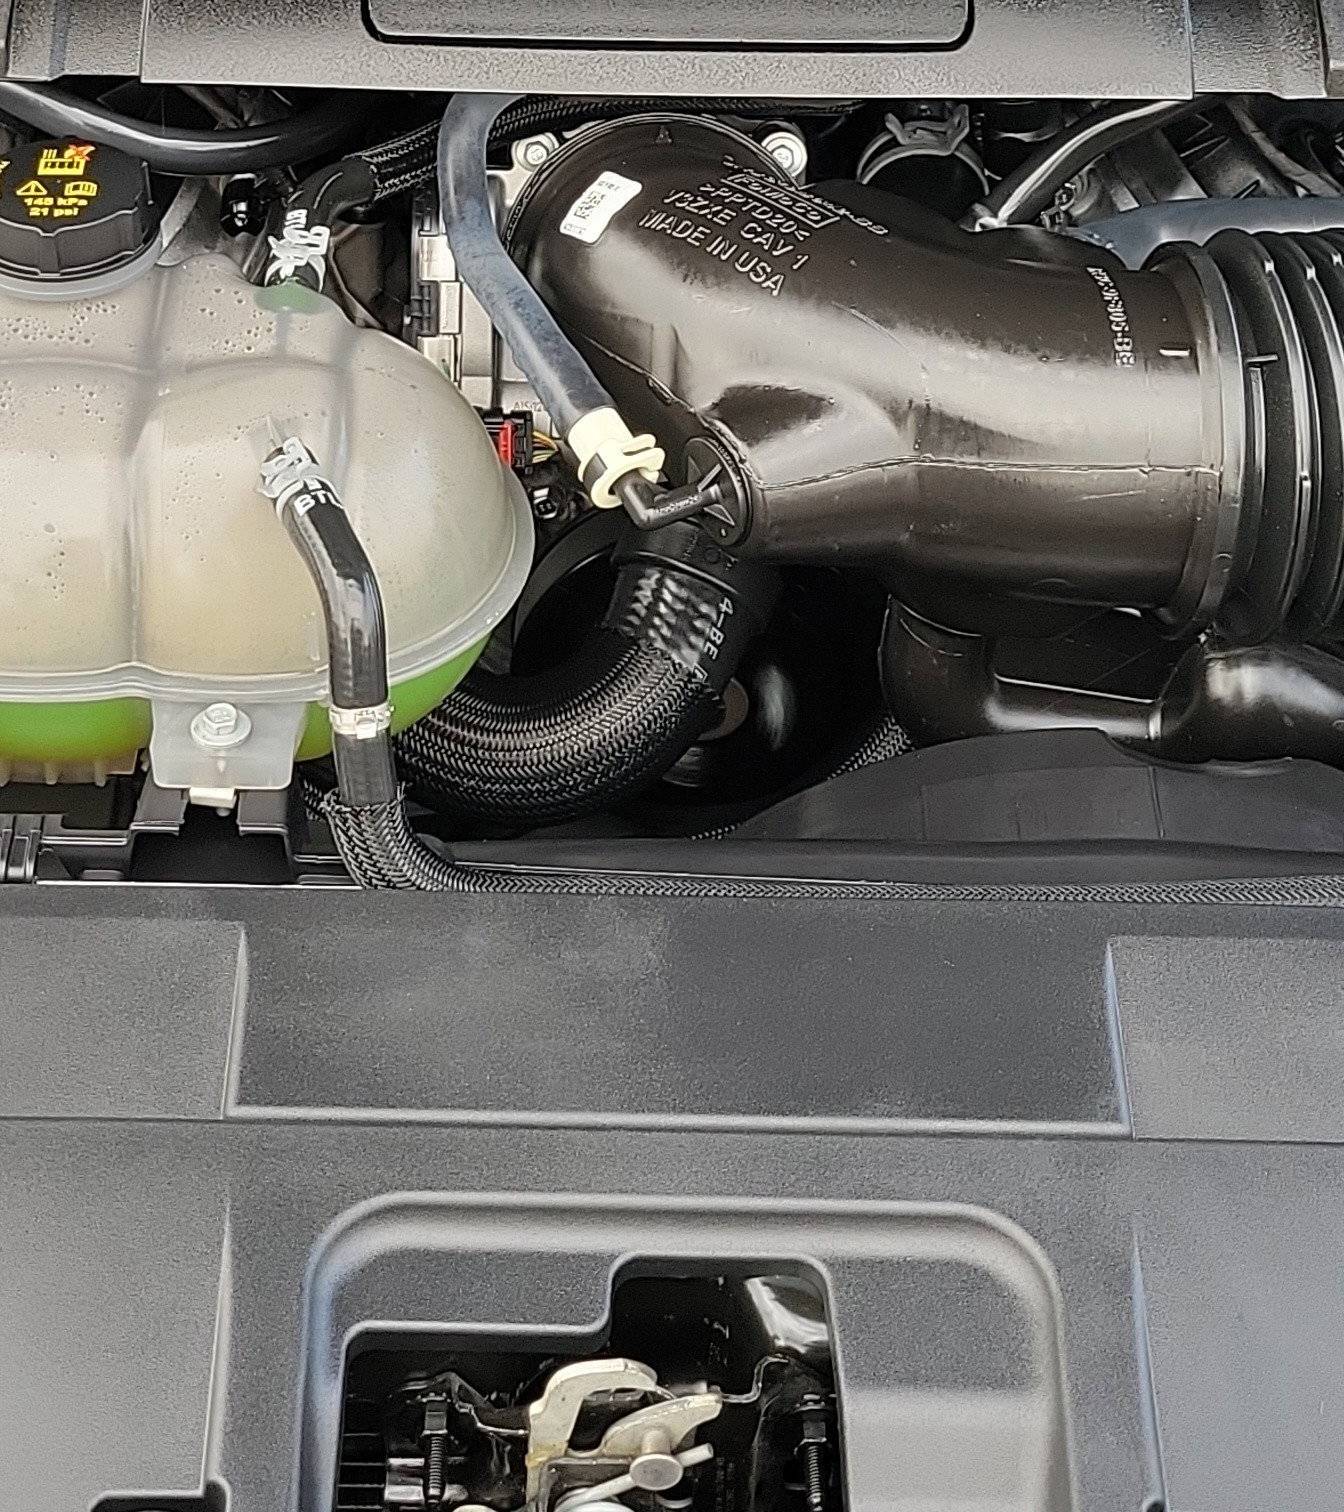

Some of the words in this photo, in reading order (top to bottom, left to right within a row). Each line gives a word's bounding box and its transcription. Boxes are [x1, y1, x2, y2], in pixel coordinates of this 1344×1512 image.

[24, 197, 54, 206] 145
[57, 197, 88, 206] kPa
[29, 208, 49, 216] 21
[53, 207, 78, 217] psi
[740, 221, 795, 258] CAV
[638, 208, 711, 247] MADE
[705, 235, 739, 261] IN
[734, 250, 787, 297] USA
